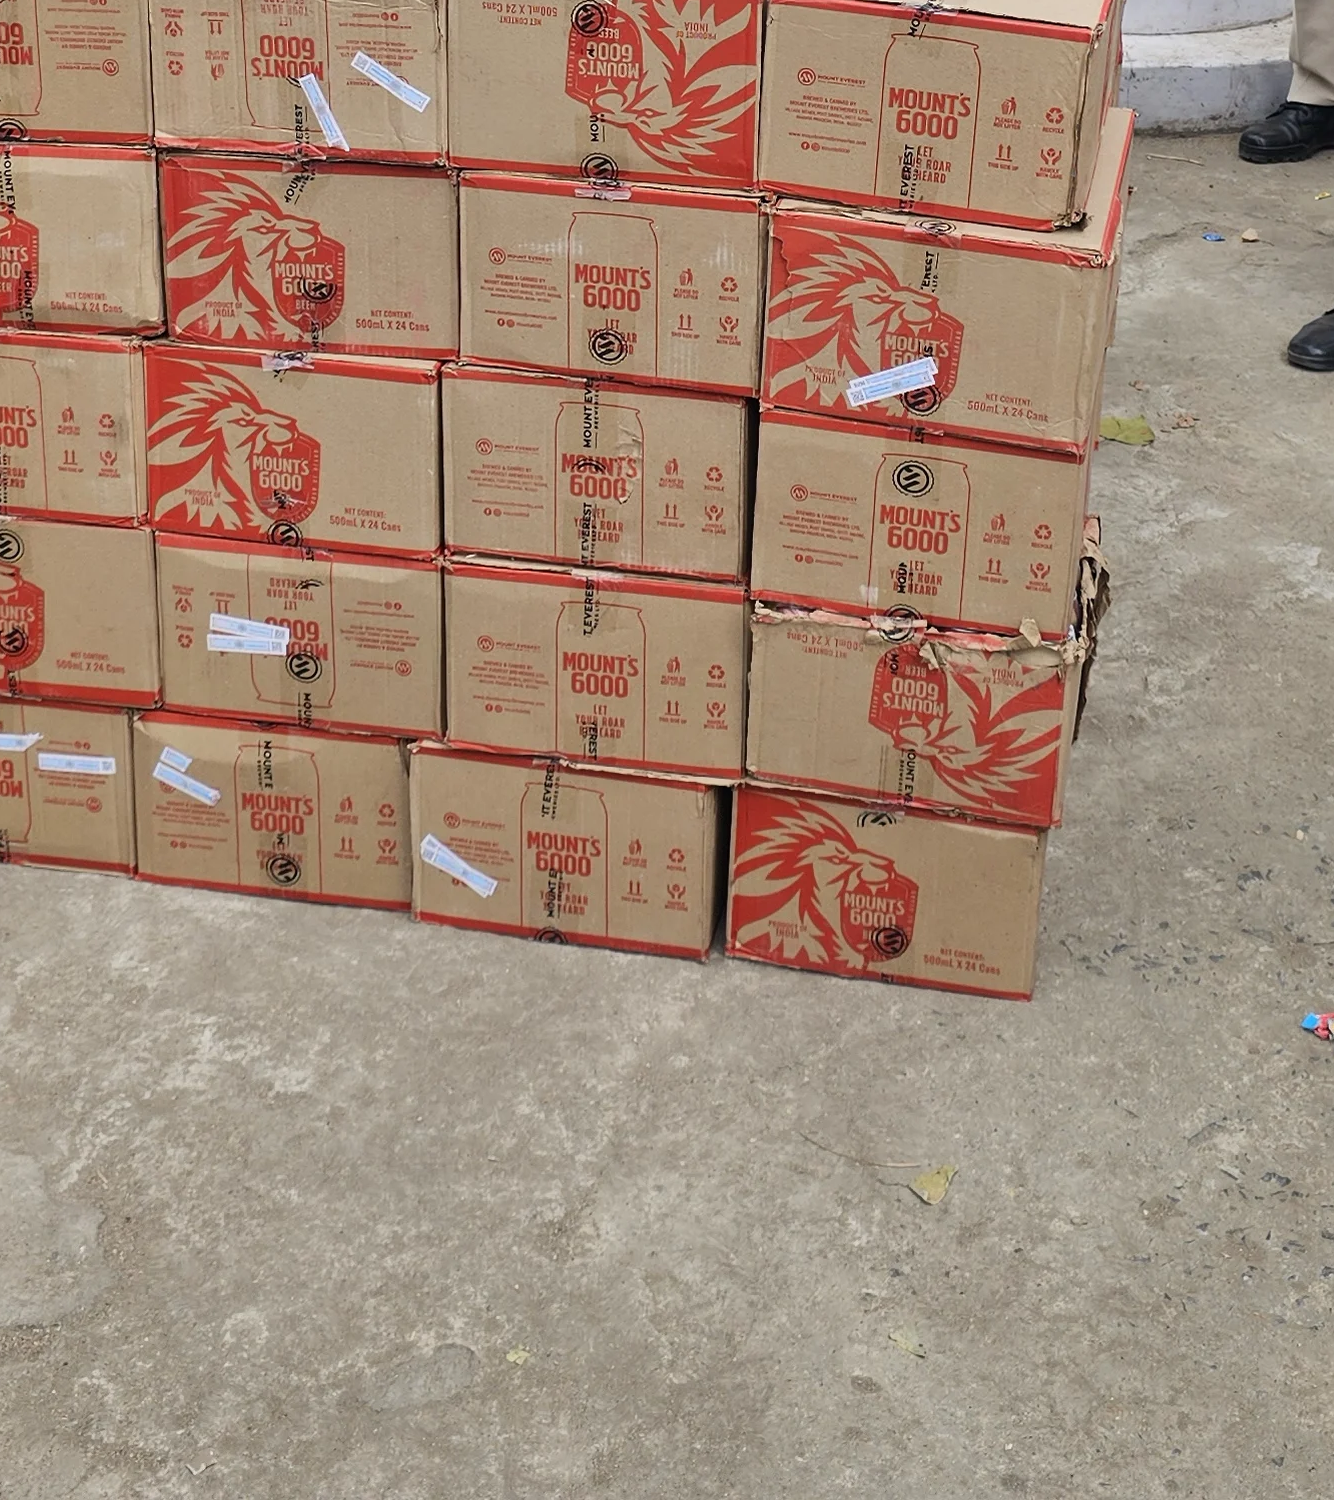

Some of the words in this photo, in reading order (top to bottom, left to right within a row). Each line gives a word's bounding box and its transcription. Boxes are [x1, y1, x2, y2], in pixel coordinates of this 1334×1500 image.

[507, 3, 517, 14] 24
[518, 4, 525, 14] X
[258, 35, 316, 60] 6000
[586, 41, 633, 62] 6000
[251, 57, 324, 81] MOUNT'S
[577, 59, 640, 79] MOUNT'S
[888, 87, 971, 117] MOUNT'S
[895, 110, 959, 140] 6000
[3, 150, 15, 193] MOUNT
[900, 144, 915, 197] EVEREST
[926, 160, 951, 173] ROAR
[275, 262, 334, 280] MOUNT'S
[574, 263, 652, 290] MOUNT'S
[583, 285, 641, 312] 6000
[212, 309, 236, 318] INDIA
[605, 319, 620, 330] LET
[387, 320, 394, 330] X
[396, 320, 407, 331] 24
[813, 373, 837, 385] INDIA
[1002, 405, 1009, 416] X
[1011, 407, 1023, 418] 24
[583, 406, 593, 449] MOUNT
[253, 455, 310, 476] MOUNT'S
[561, 453, 638, 478] MOUNT'S
[258, 472, 302, 492] 6000
[569, 474, 628, 500] 6000
[192, 497, 214, 507] INDIA
[368, 519, 379, 530] 24
[582, 502, 593, 557] EVEREST
[600, 520, 623, 532] ROAR
[880, 504, 961, 533] MOUNT'S
[887, 525, 949, 555] 6000
[909, 560, 924, 572] LET
[918, 573, 943, 586] ROAR
[562, 651, 639, 678] MOUNT'S
[905, 664, 927, 677] BEER
[570, 672, 629, 698] 6000
[891, 676, 939, 699] 6000
[593, 704, 608, 715] LET
[882, 691, 944, 717] MOUNT'S
[601, 716, 626, 728] ROAR
[263, 740, 273, 781] MOUNT
[241, 792, 314, 816] MOUNT'S
[250, 811, 305, 836] 6000
[526, 830, 601, 858] MOUNT'S
[535, 851, 592, 877] 6000
[850, 908, 896, 927] 6000
